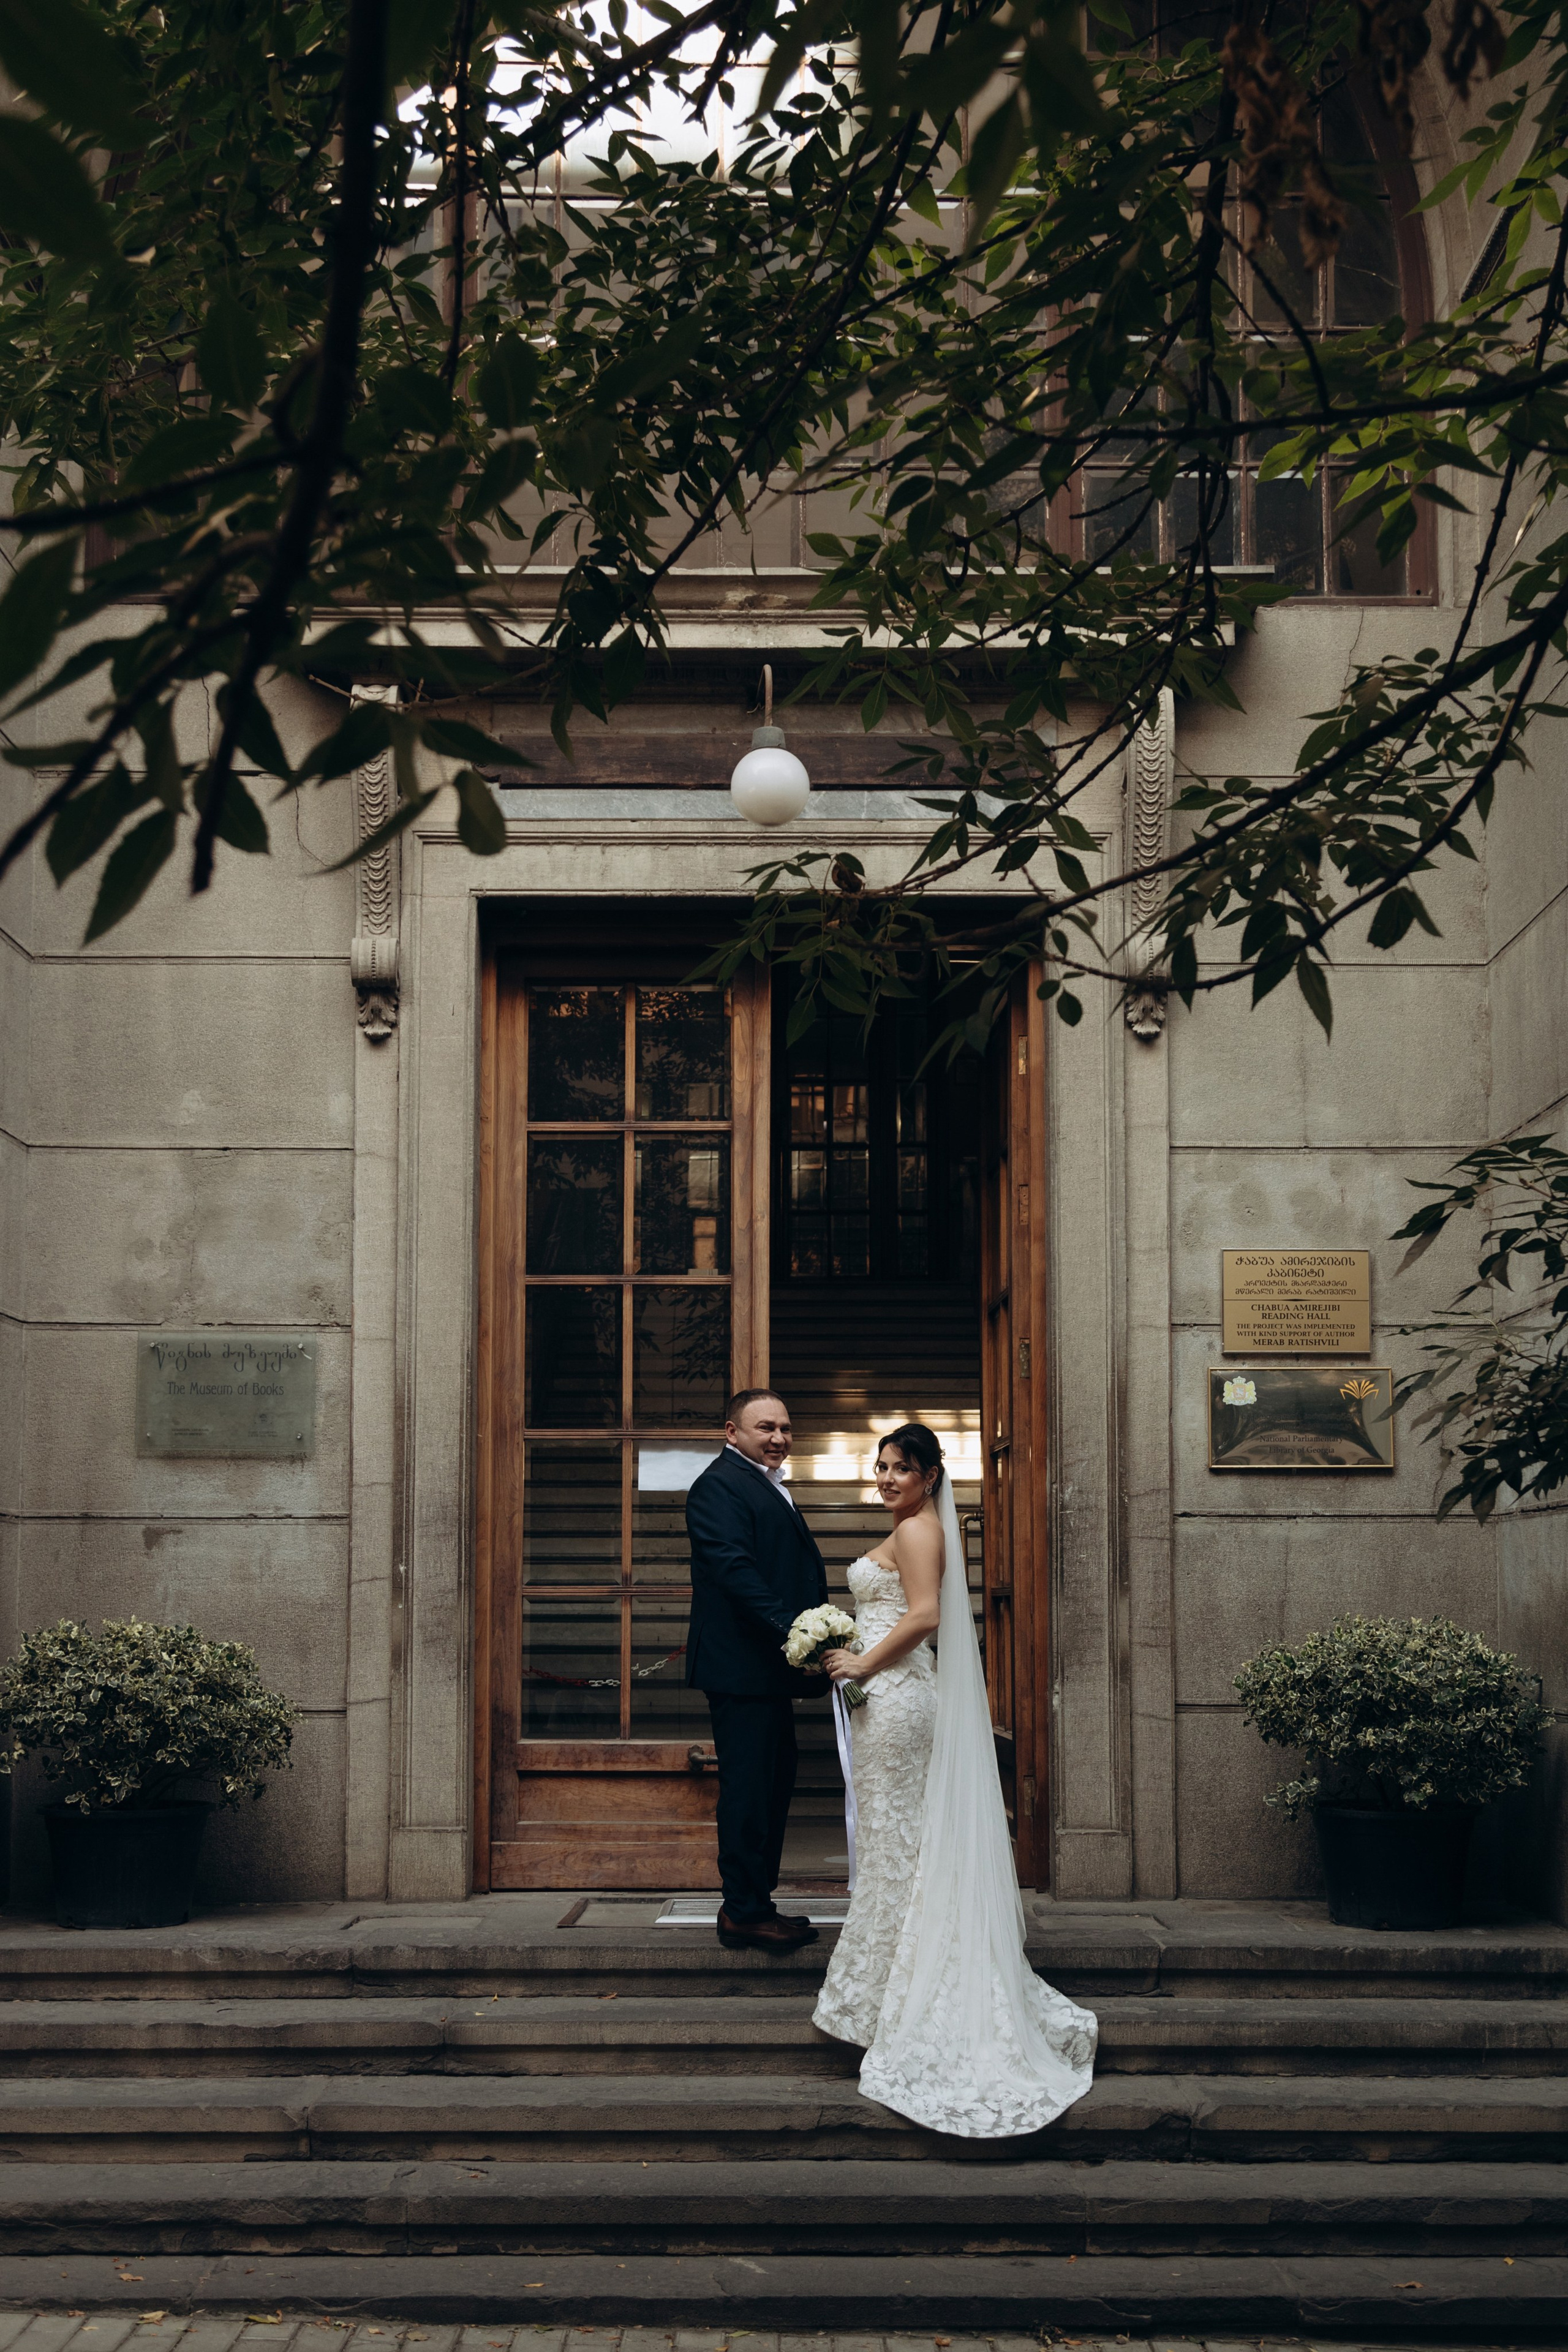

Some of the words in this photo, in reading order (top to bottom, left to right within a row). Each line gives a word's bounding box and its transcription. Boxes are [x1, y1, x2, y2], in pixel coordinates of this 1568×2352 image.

[167, 1382, 185, 1395] The
[190, 1382, 233, 1395] Museum
[238, 1382, 248, 1395] of
[252, 1382, 284, 1395] Books
[1292, 1435, 1343, 1444] Parliamentary
[1268, 1446, 1295, 1455] Library
